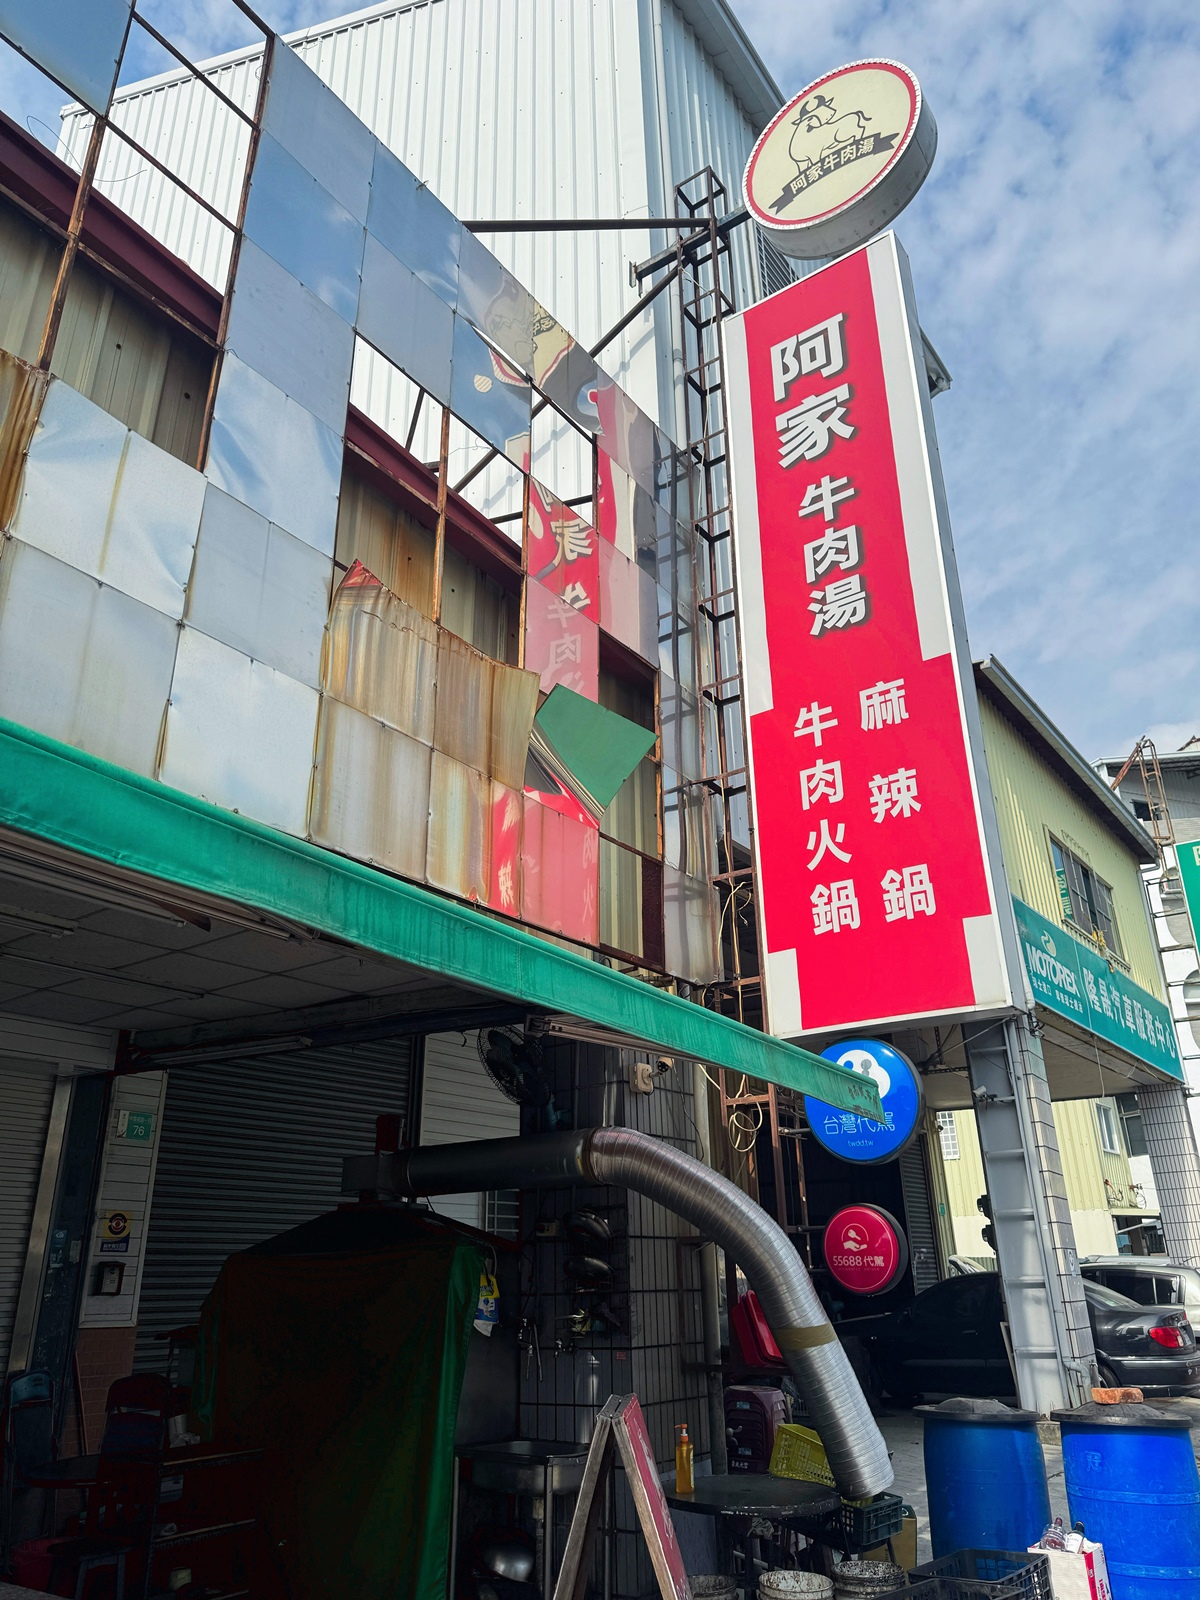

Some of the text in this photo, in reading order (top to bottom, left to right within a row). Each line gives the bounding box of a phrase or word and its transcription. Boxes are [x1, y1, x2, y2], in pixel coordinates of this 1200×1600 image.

[789, 138, 875, 194] 阿家牛肉湯
[769, 312, 867, 636] 阿家牛肉湯
[793, 701, 861, 935] 牛肉火鍋
[858, 678, 937, 923] 麻辣鍋
[1026, 942, 1081, 998] MOTOREX
[132, 1124, 145, 1137] 76
[847, 1139, 874, 1148] twdd.tw
